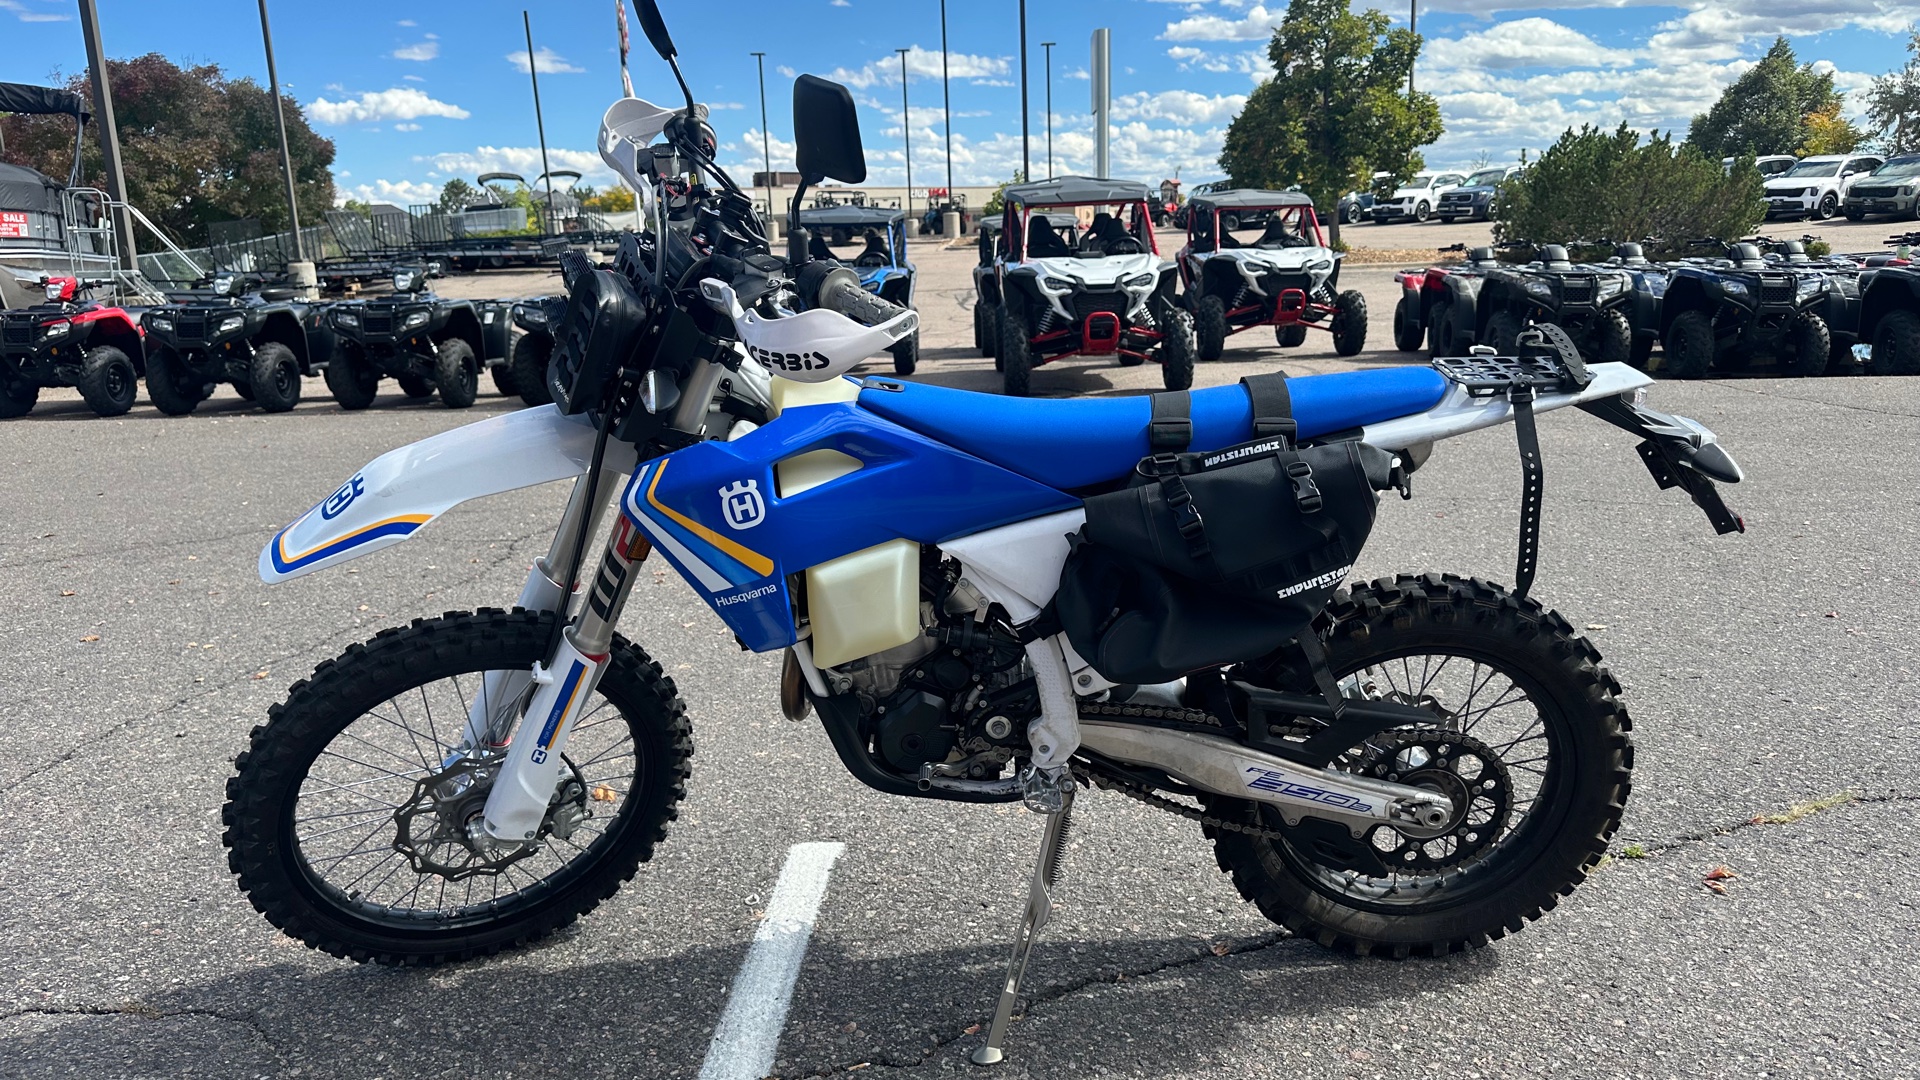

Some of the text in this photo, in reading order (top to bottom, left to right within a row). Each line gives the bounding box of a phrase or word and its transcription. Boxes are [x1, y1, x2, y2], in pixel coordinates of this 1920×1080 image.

[3, 213, 25, 223] SALE
[1204, 440, 1280, 467] ENDURISTAN
[1277, 564, 1352, 599] ENDURISTAN
[715, 584, 777, 607] Husqvarna
